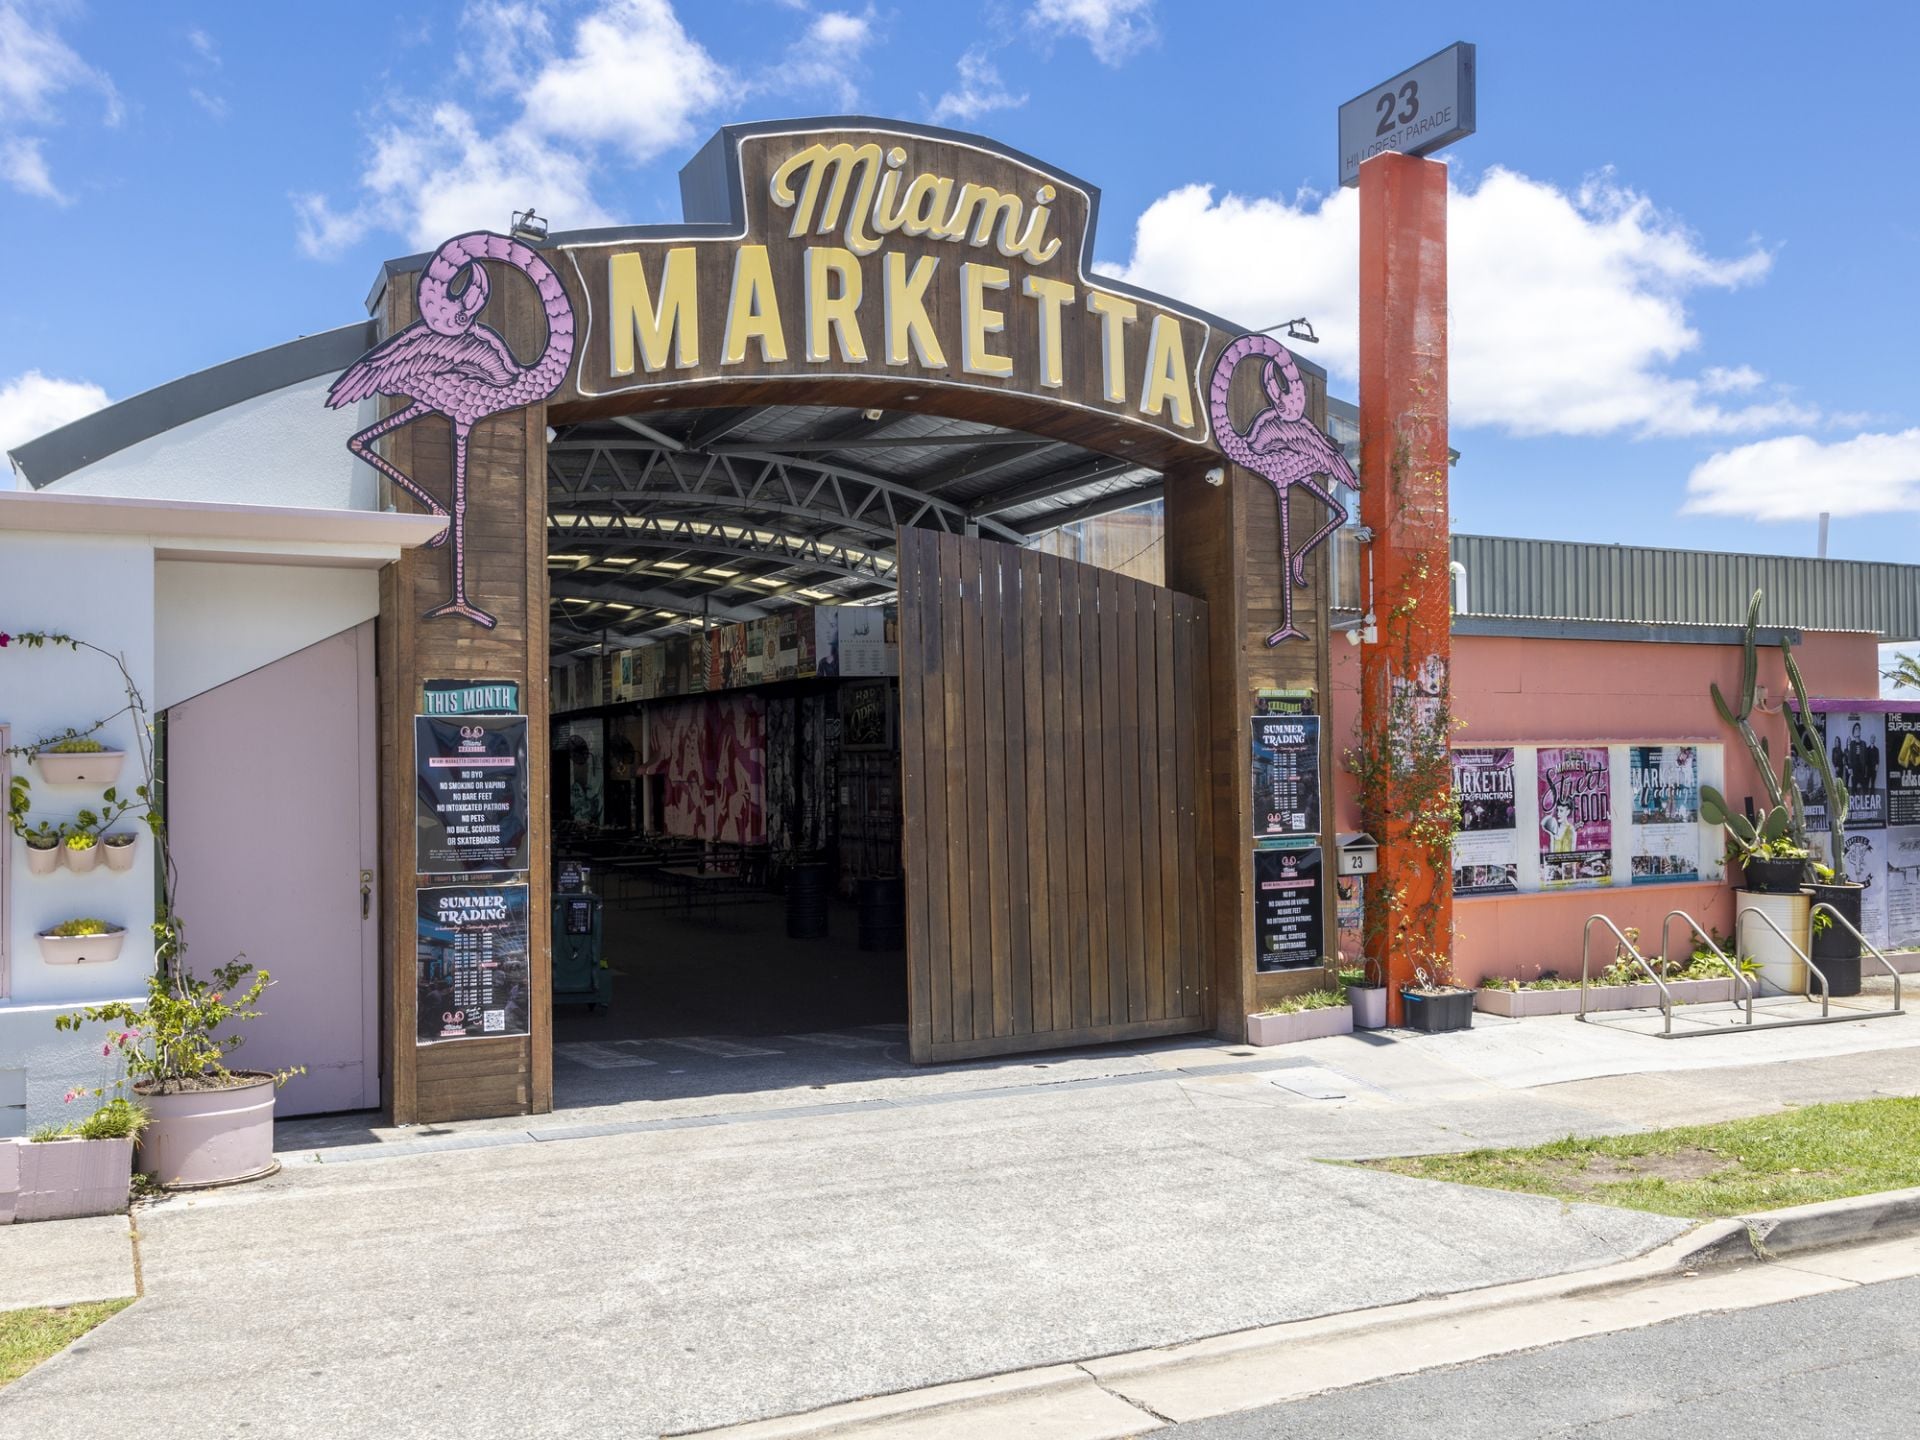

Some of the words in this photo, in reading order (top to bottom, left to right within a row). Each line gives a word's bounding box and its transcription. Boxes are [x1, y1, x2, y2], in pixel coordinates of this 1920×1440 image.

[1376, 80, 1419, 137] 23
[1405, 106, 1452, 141] PARADE
[770, 143, 1062, 265] Miami
[608, 245, 1196, 429] MARKETTA
[426, 692, 458, 713] THIS
[463, 687, 511, 710] MONTH
[1888, 713, 1902, 722] THE
[1263, 725, 1306, 736] SUMMER
[1262, 735, 1305, 746] TRADING
[462, 771, 471, 779] NO
[1453, 766, 1513, 793] ARKETTA
[440, 782, 449, 790] NO
[485, 781, 506, 789] VAPING
[1542, 762, 1608, 812] Street
[453, 793, 462, 801] NO
[479, 792, 492, 800] FEET
[1475, 792, 1513, 801] FUNCTIONS
[1849, 795, 1882, 810] RCLEAR
[437, 804, 445, 812] NO
[446, 803, 482, 812] INTOXICATED
[483, 803, 510, 811] PATRONS
[1573, 792, 1608, 823] FOOD
[471, 814, 485, 822] PETS
[447, 826, 455, 834] NO
[472, 824, 501, 833] SCOOTERS
[447, 837, 456, 845] OR
[457, 836, 500, 845] SKATEBOARDS
[1352, 856, 1363, 869] 23
[440, 896, 507, 910] SUMMER
[437, 908, 506, 924] TRADING
